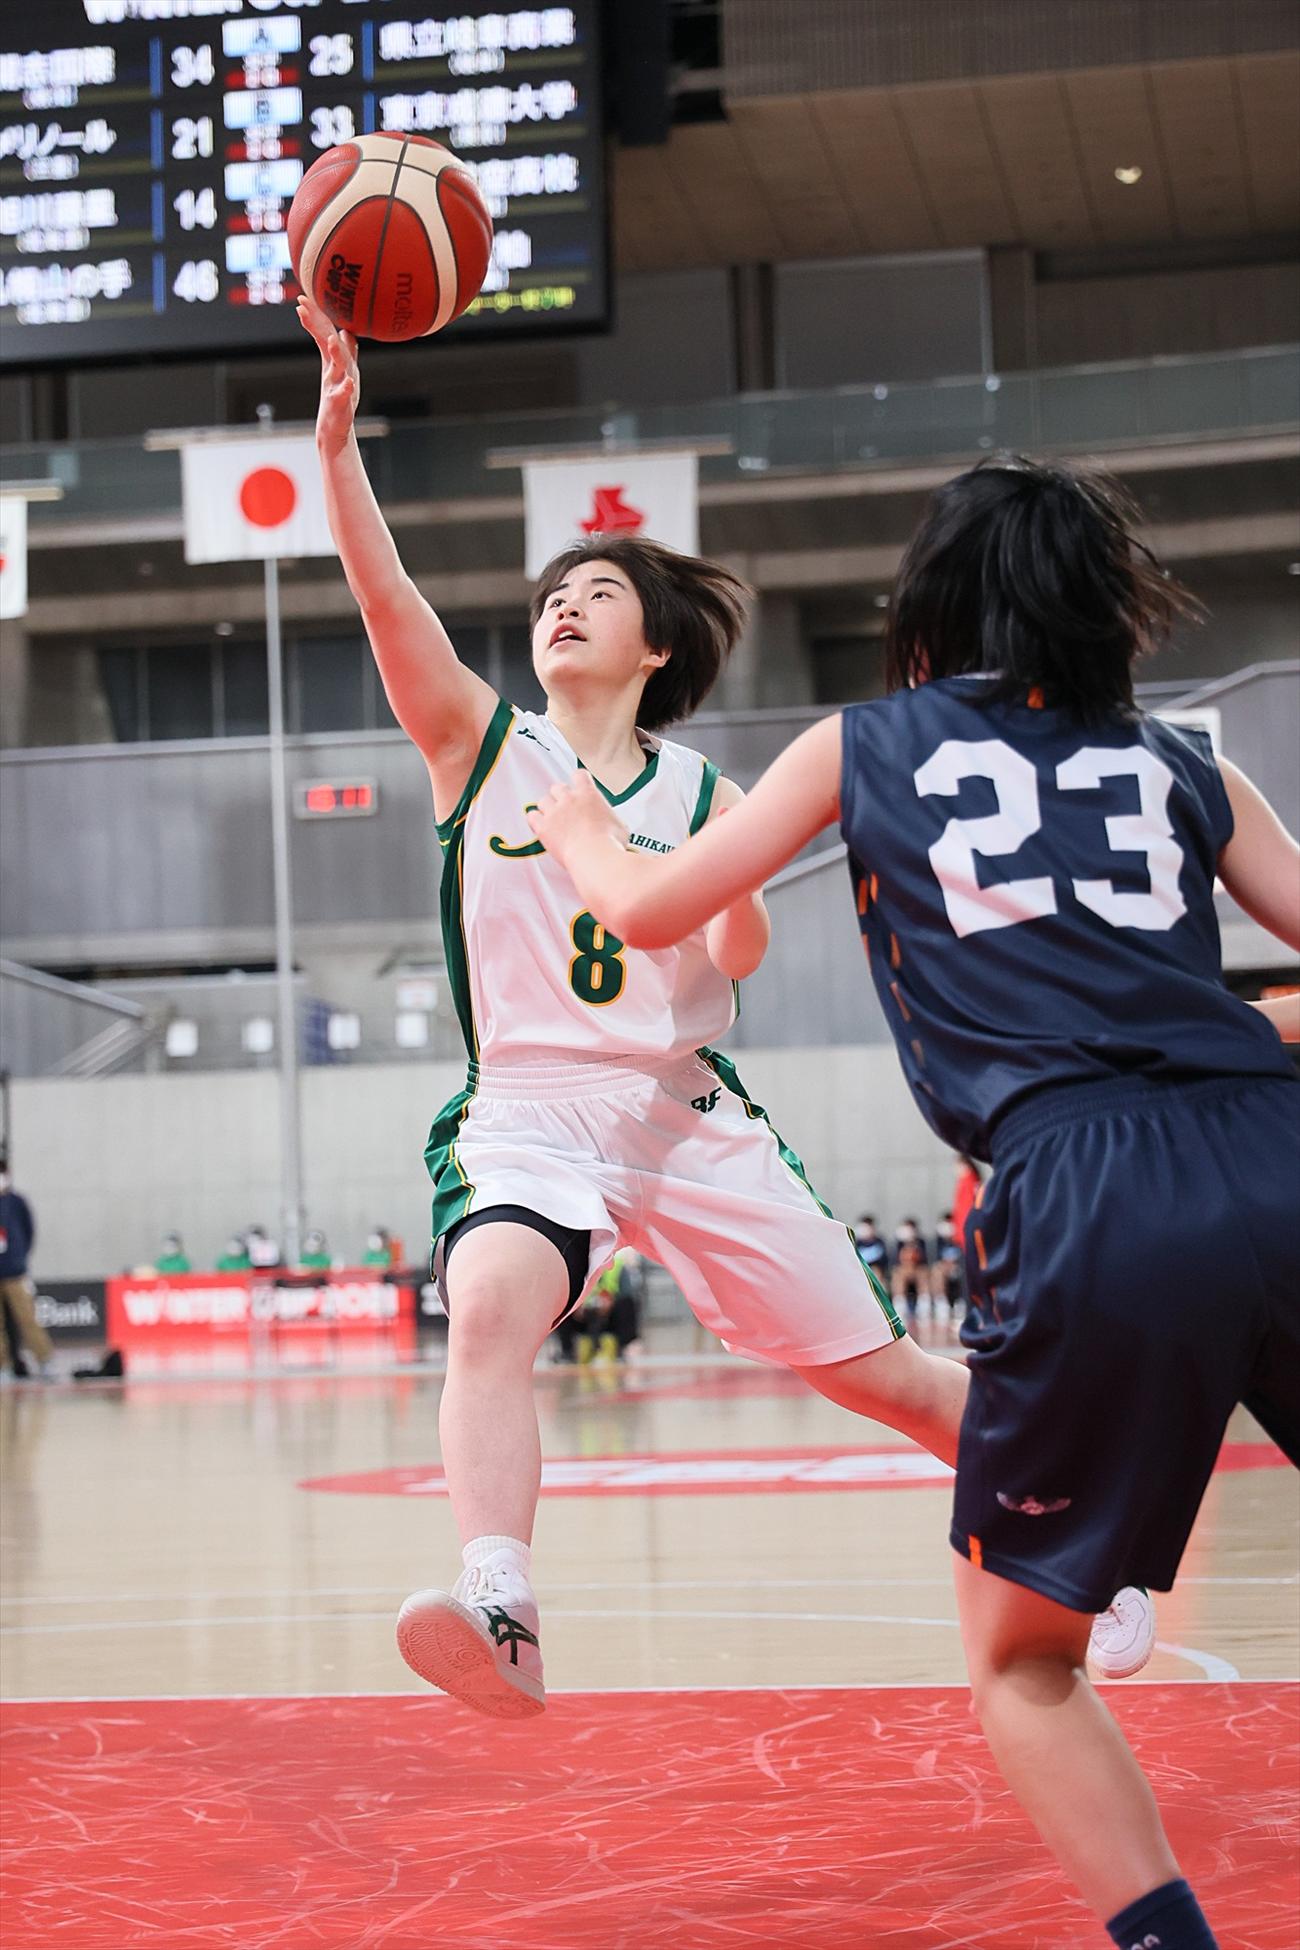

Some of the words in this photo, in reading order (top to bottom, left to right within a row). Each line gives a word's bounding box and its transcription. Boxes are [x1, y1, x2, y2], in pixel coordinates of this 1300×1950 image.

[171, 45, 215, 88] 34
[309, 34, 354, 76] 25
[172, 117, 213, 159] 21
[173, 188, 217, 231] 14
[914, 739, 1187, 938] 23
[568, 907, 627, 1007] 8
